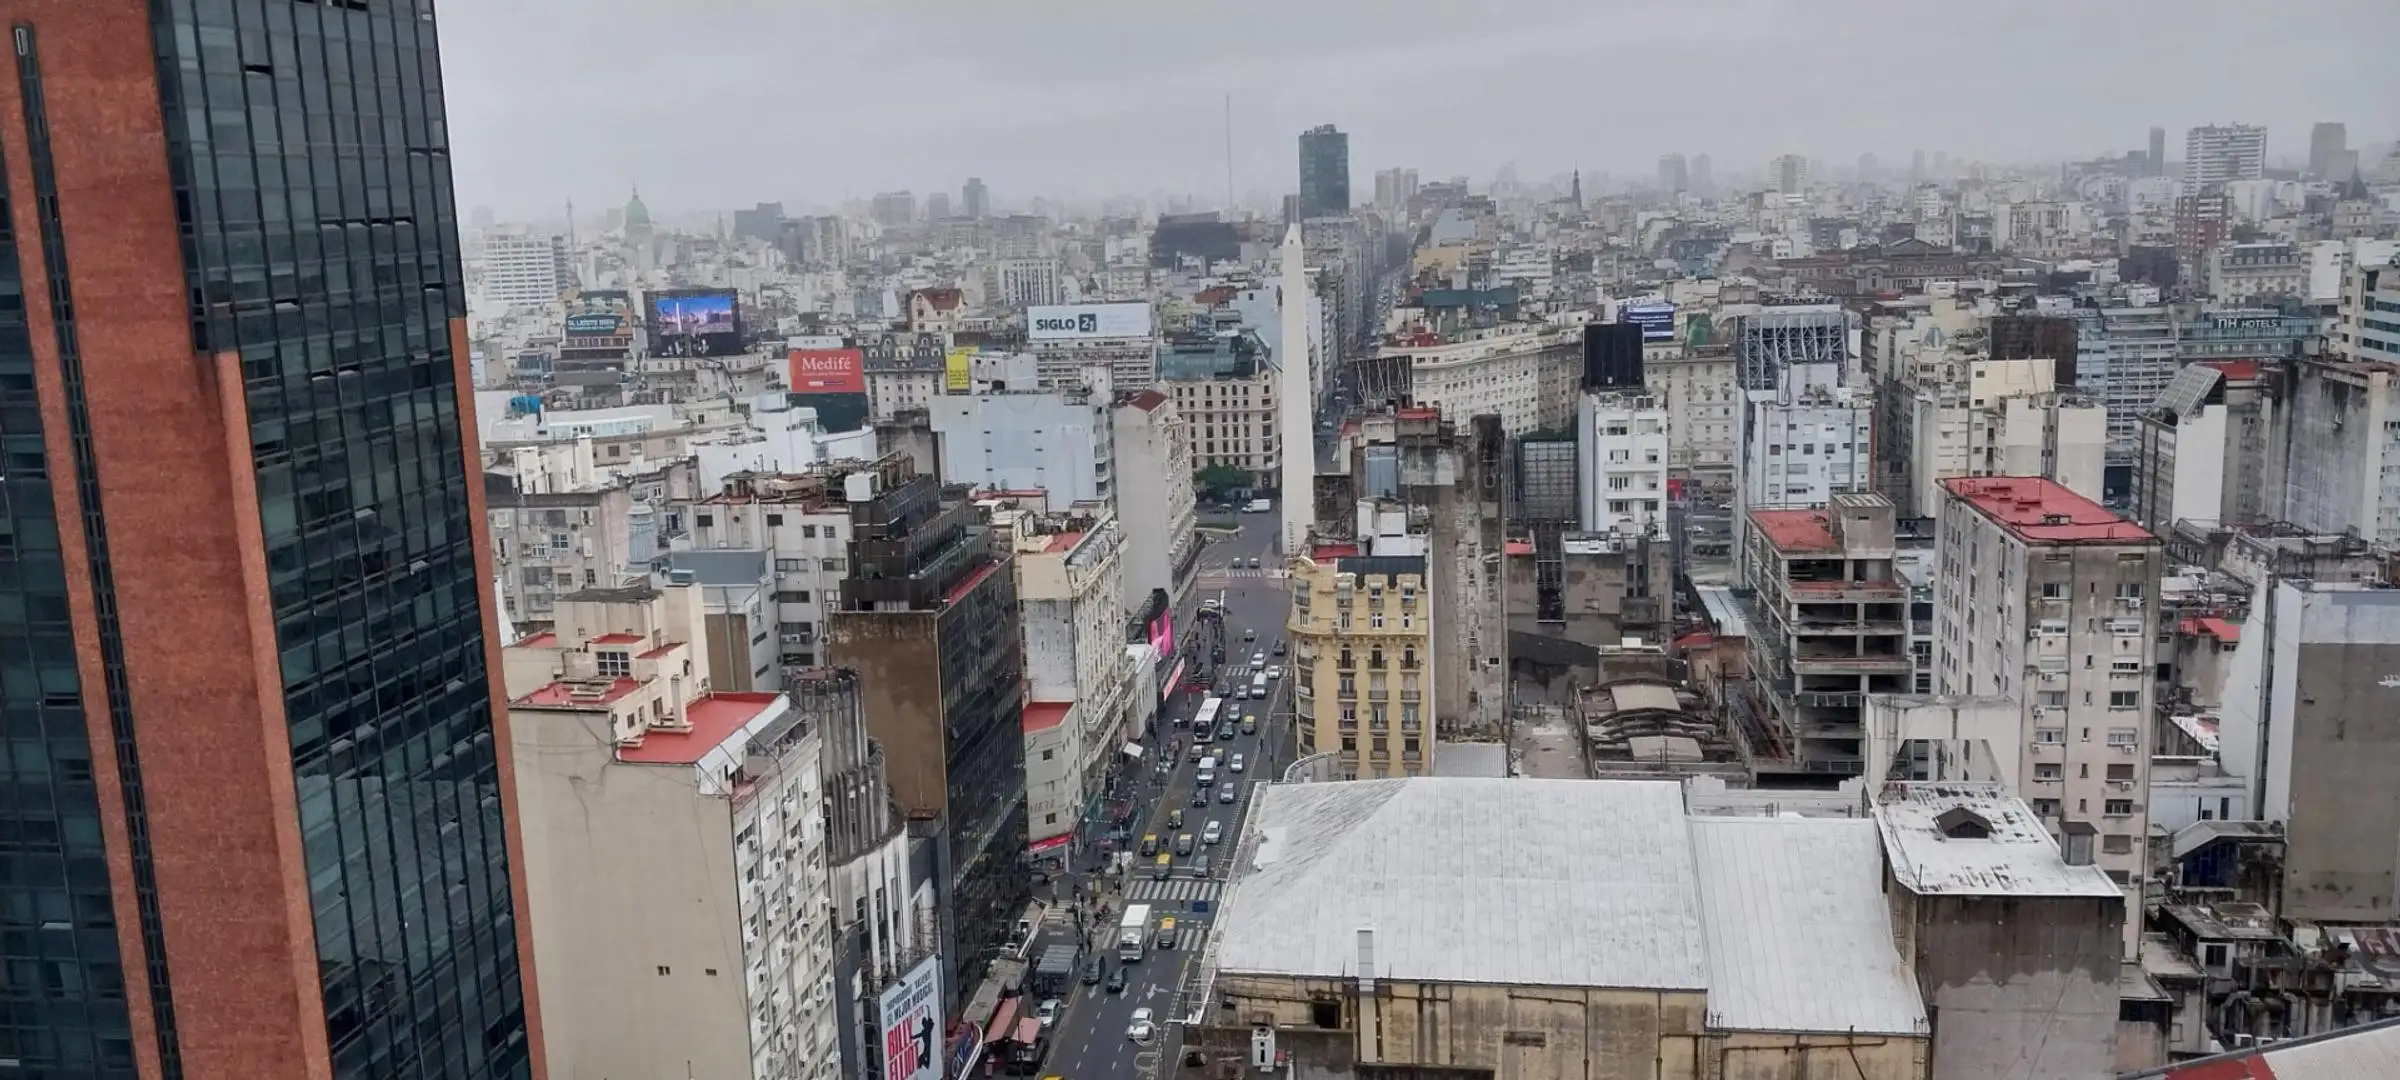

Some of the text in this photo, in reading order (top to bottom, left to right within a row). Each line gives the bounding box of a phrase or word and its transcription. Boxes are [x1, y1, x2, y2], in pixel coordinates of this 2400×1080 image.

[1036, 318, 1075, 331] SIGLO
[2241, 320, 2279, 329] HOTELS
[802, 356, 852, 370] Medifé
[887, 1014, 913, 1062] BILLY
